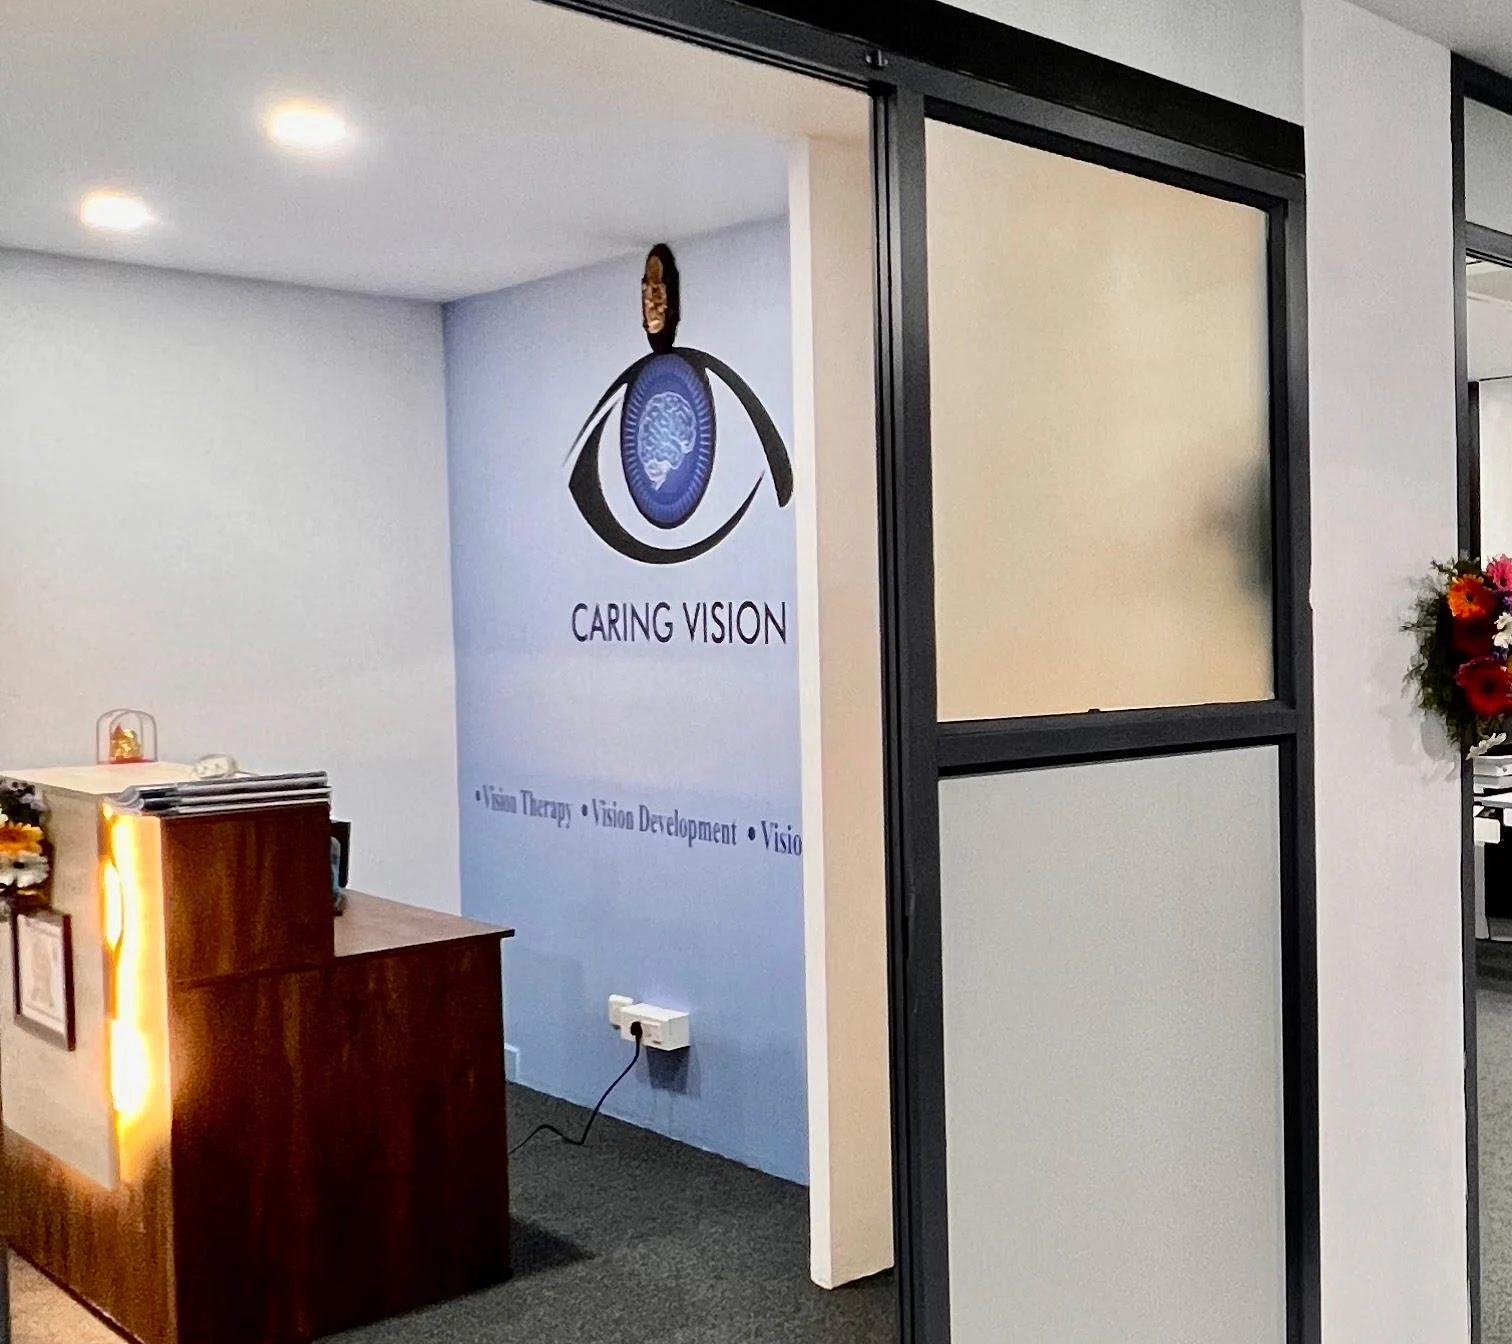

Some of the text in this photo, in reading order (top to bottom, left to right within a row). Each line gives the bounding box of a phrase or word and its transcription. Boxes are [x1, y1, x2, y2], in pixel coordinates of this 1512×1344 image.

[571, 600, 788, 645] CARING VISION
[520, 789, 573, 829] Therapy
[592, 798, 635, 830] Vision
[639, 804, 737, 848] Development
